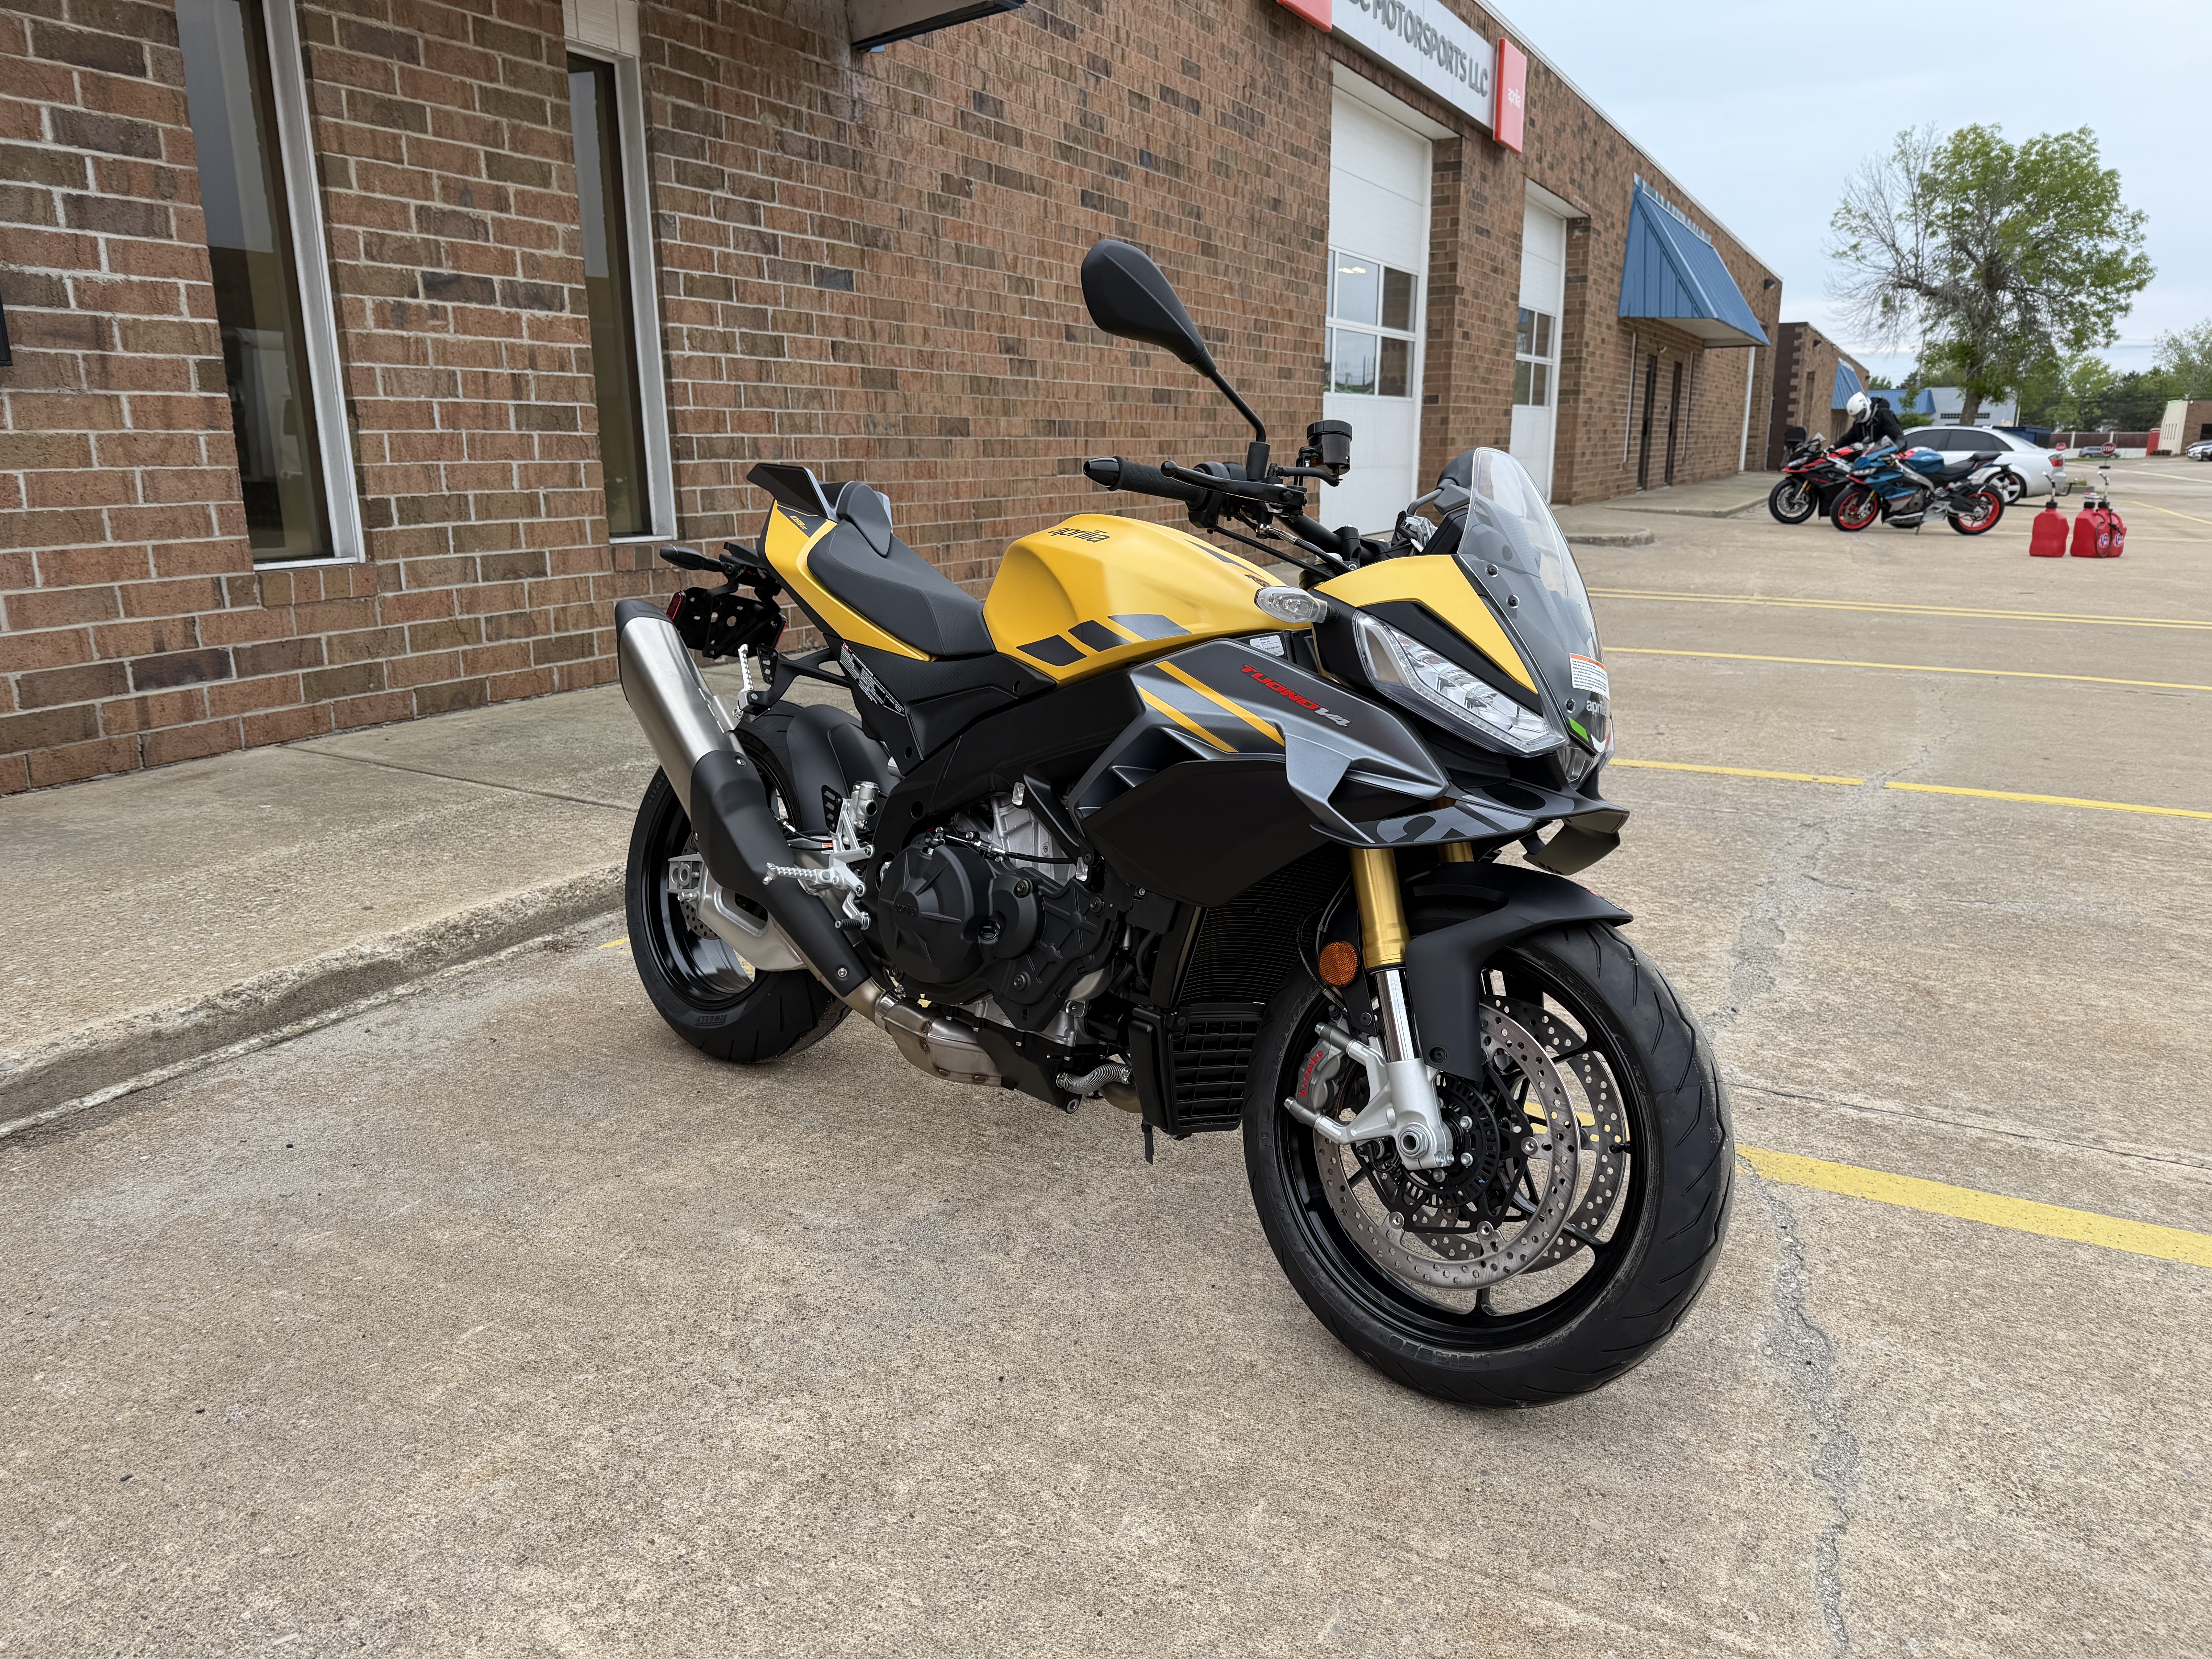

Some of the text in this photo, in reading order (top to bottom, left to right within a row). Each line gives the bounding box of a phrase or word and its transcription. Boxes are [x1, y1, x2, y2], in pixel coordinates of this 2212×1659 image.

[1373, 0, 1488, 97] MOTORSPORTS LLC
[1047, 528, 1110, 543] aprilia
[1241, 664, 1351, 727] TUONO V4
[1298, 1050, 1323, 1097] brembo
